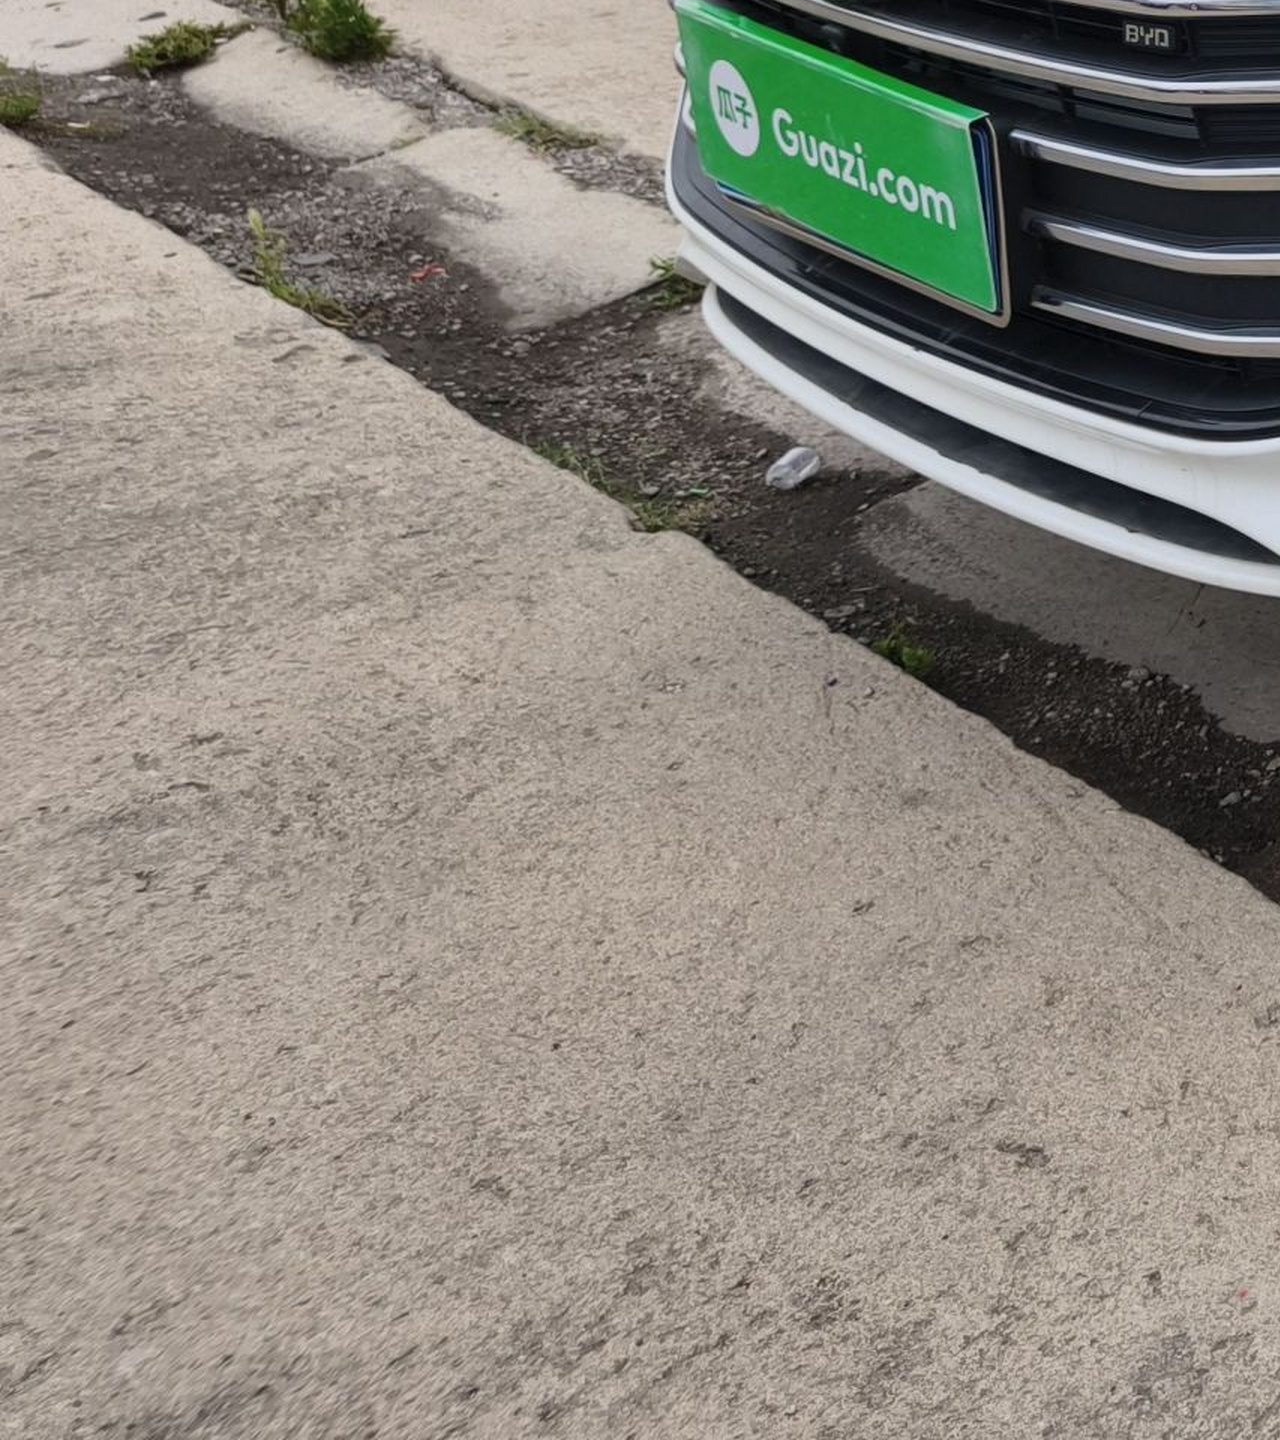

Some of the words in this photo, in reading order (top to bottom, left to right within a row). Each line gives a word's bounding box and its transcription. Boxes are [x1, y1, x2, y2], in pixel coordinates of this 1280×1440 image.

[1126, 24, 1169, 48] BYD
[716, 85, 753, 129] 瓜子
[772, 108, 957, 230] Guazi.com
